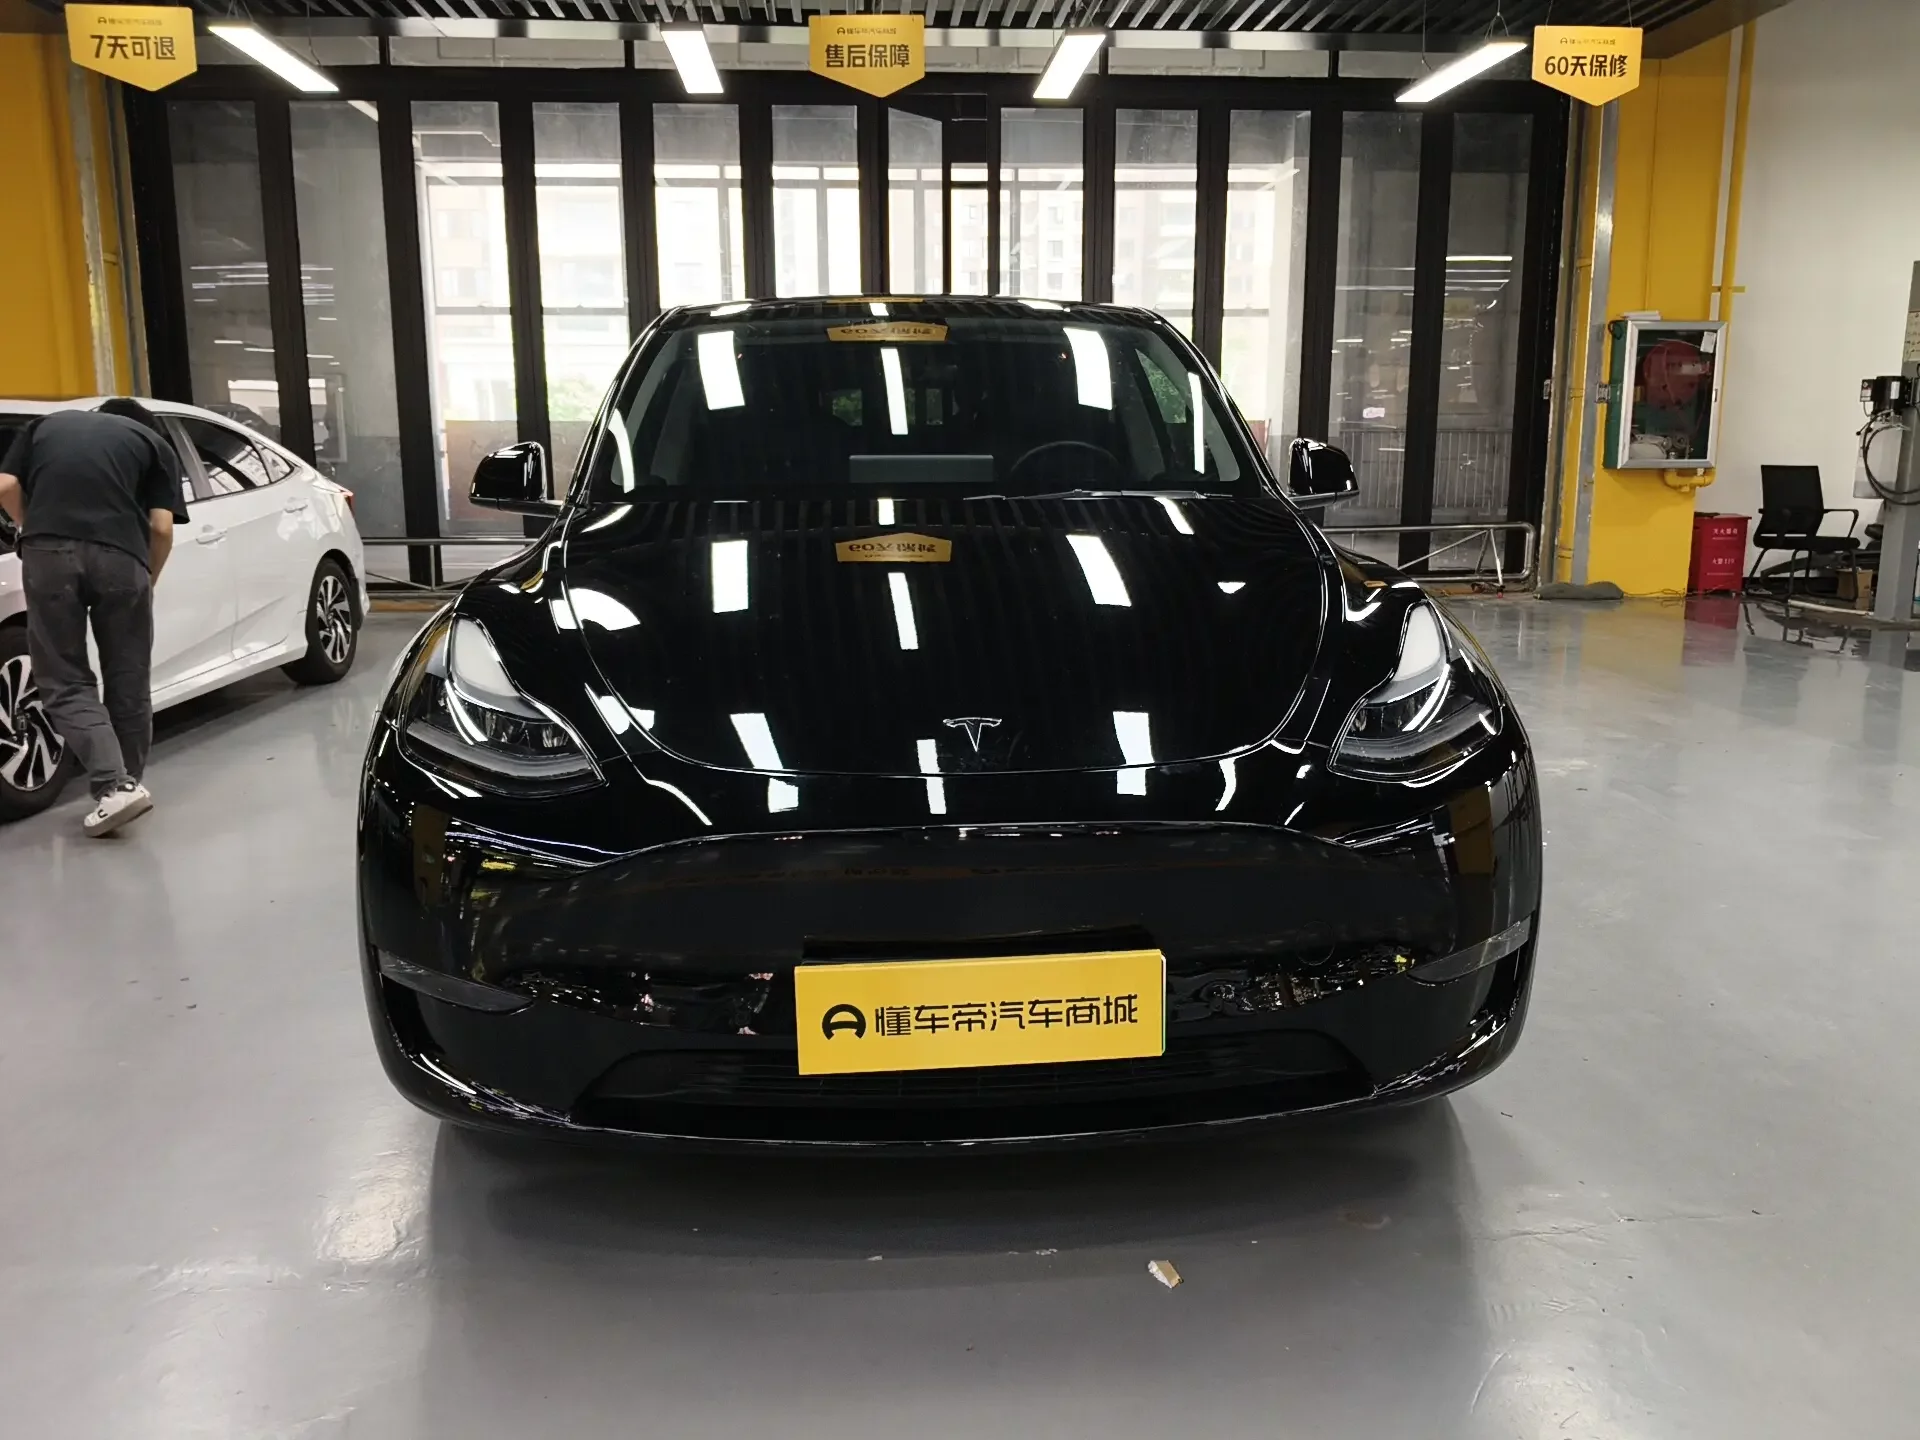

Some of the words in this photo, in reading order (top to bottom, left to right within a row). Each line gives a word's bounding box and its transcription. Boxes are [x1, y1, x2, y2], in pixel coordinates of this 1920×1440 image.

[90, 35, 176, 60] 7天可退
[825, 44, 910, 68] 售后保障
[1544, 54, 1628, 77] 60天保修
[875, 993, 1138, 1037] 懂车帝汽车商城
